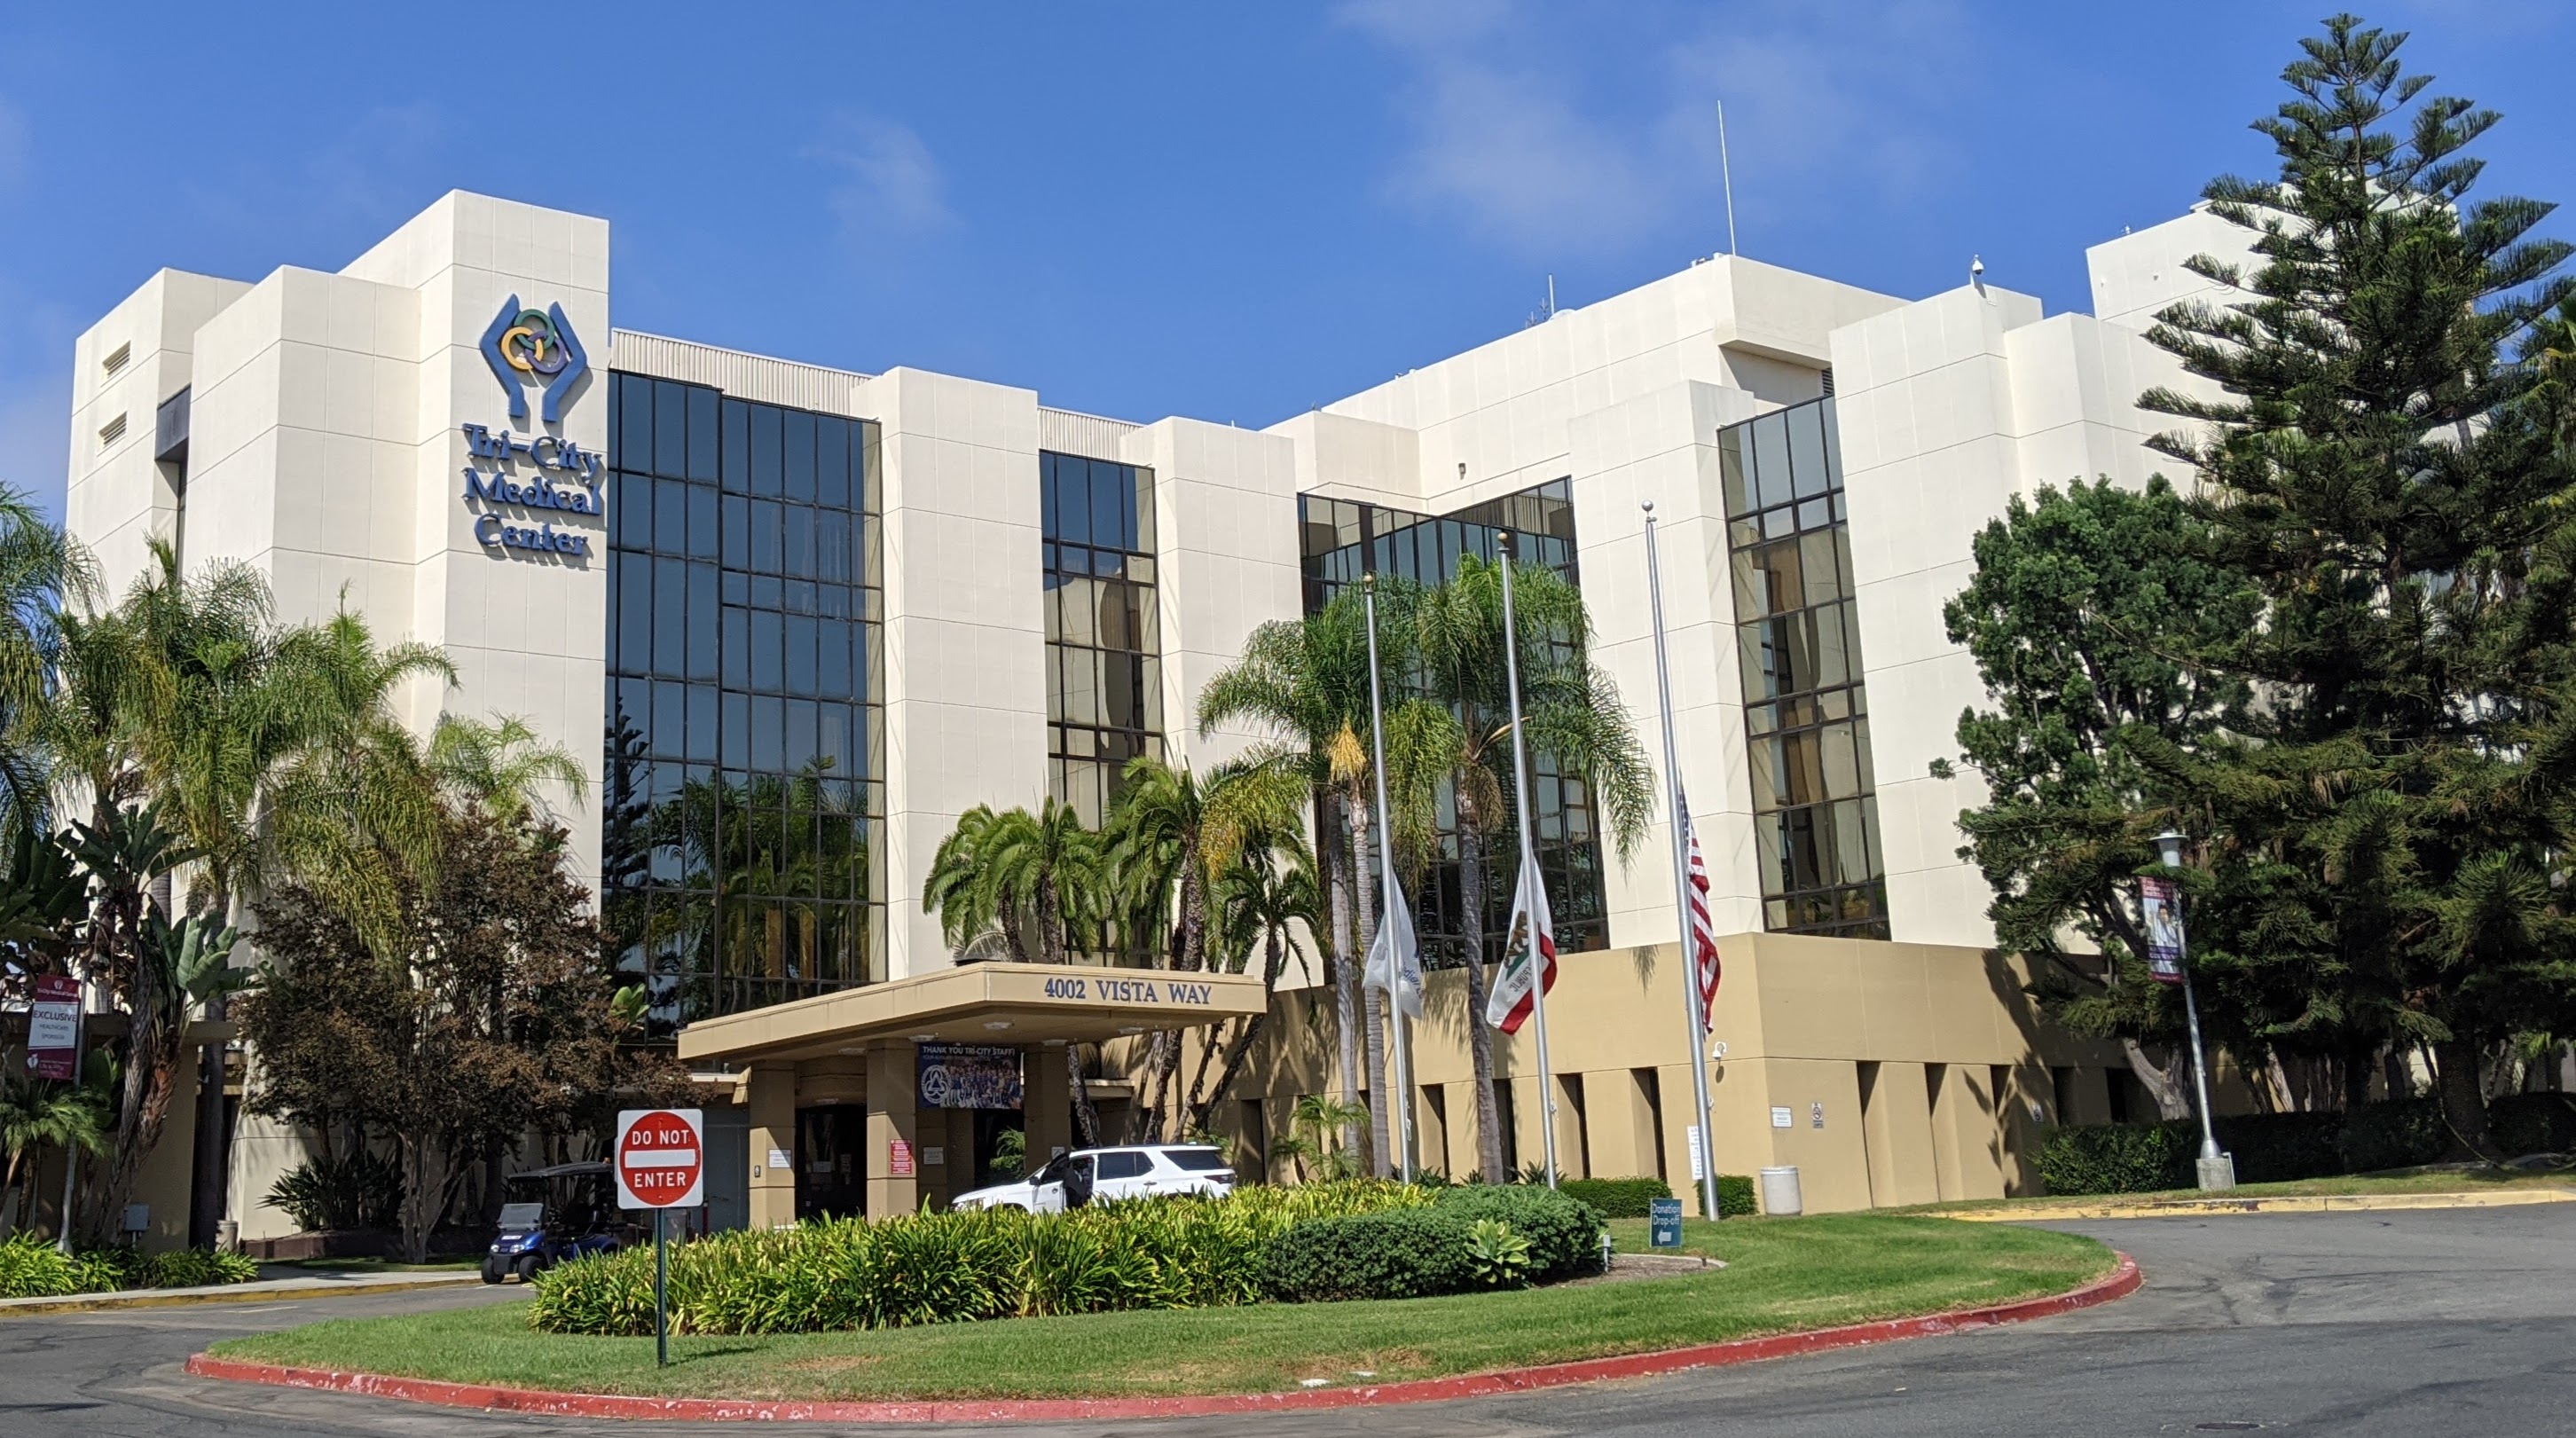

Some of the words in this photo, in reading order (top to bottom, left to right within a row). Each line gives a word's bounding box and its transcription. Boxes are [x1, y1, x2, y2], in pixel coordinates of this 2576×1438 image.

[462, 422, 602, 483] Tri-City
[462, 467, 602, 515] Medical
[474, 513, 588, 556] Center
[1044, 978, 1086, 999] 4002
[1096, 979, 1158, 1002] VISTA
[1167, 983, 1212, 1004] WAY
[33, 1010, 77, 1022] EXCLUSIVE
[948, 1046, 963, 1055] YOU
[632, 1130, 652, 1145] DO
[659, 1129, 689, 1144] NOT
[634, 1172, 686, 1188] ENTER
[1652, 1203, 1680, 1214] Donation
[1653, 1214, 1680, 1229] Drop-off
